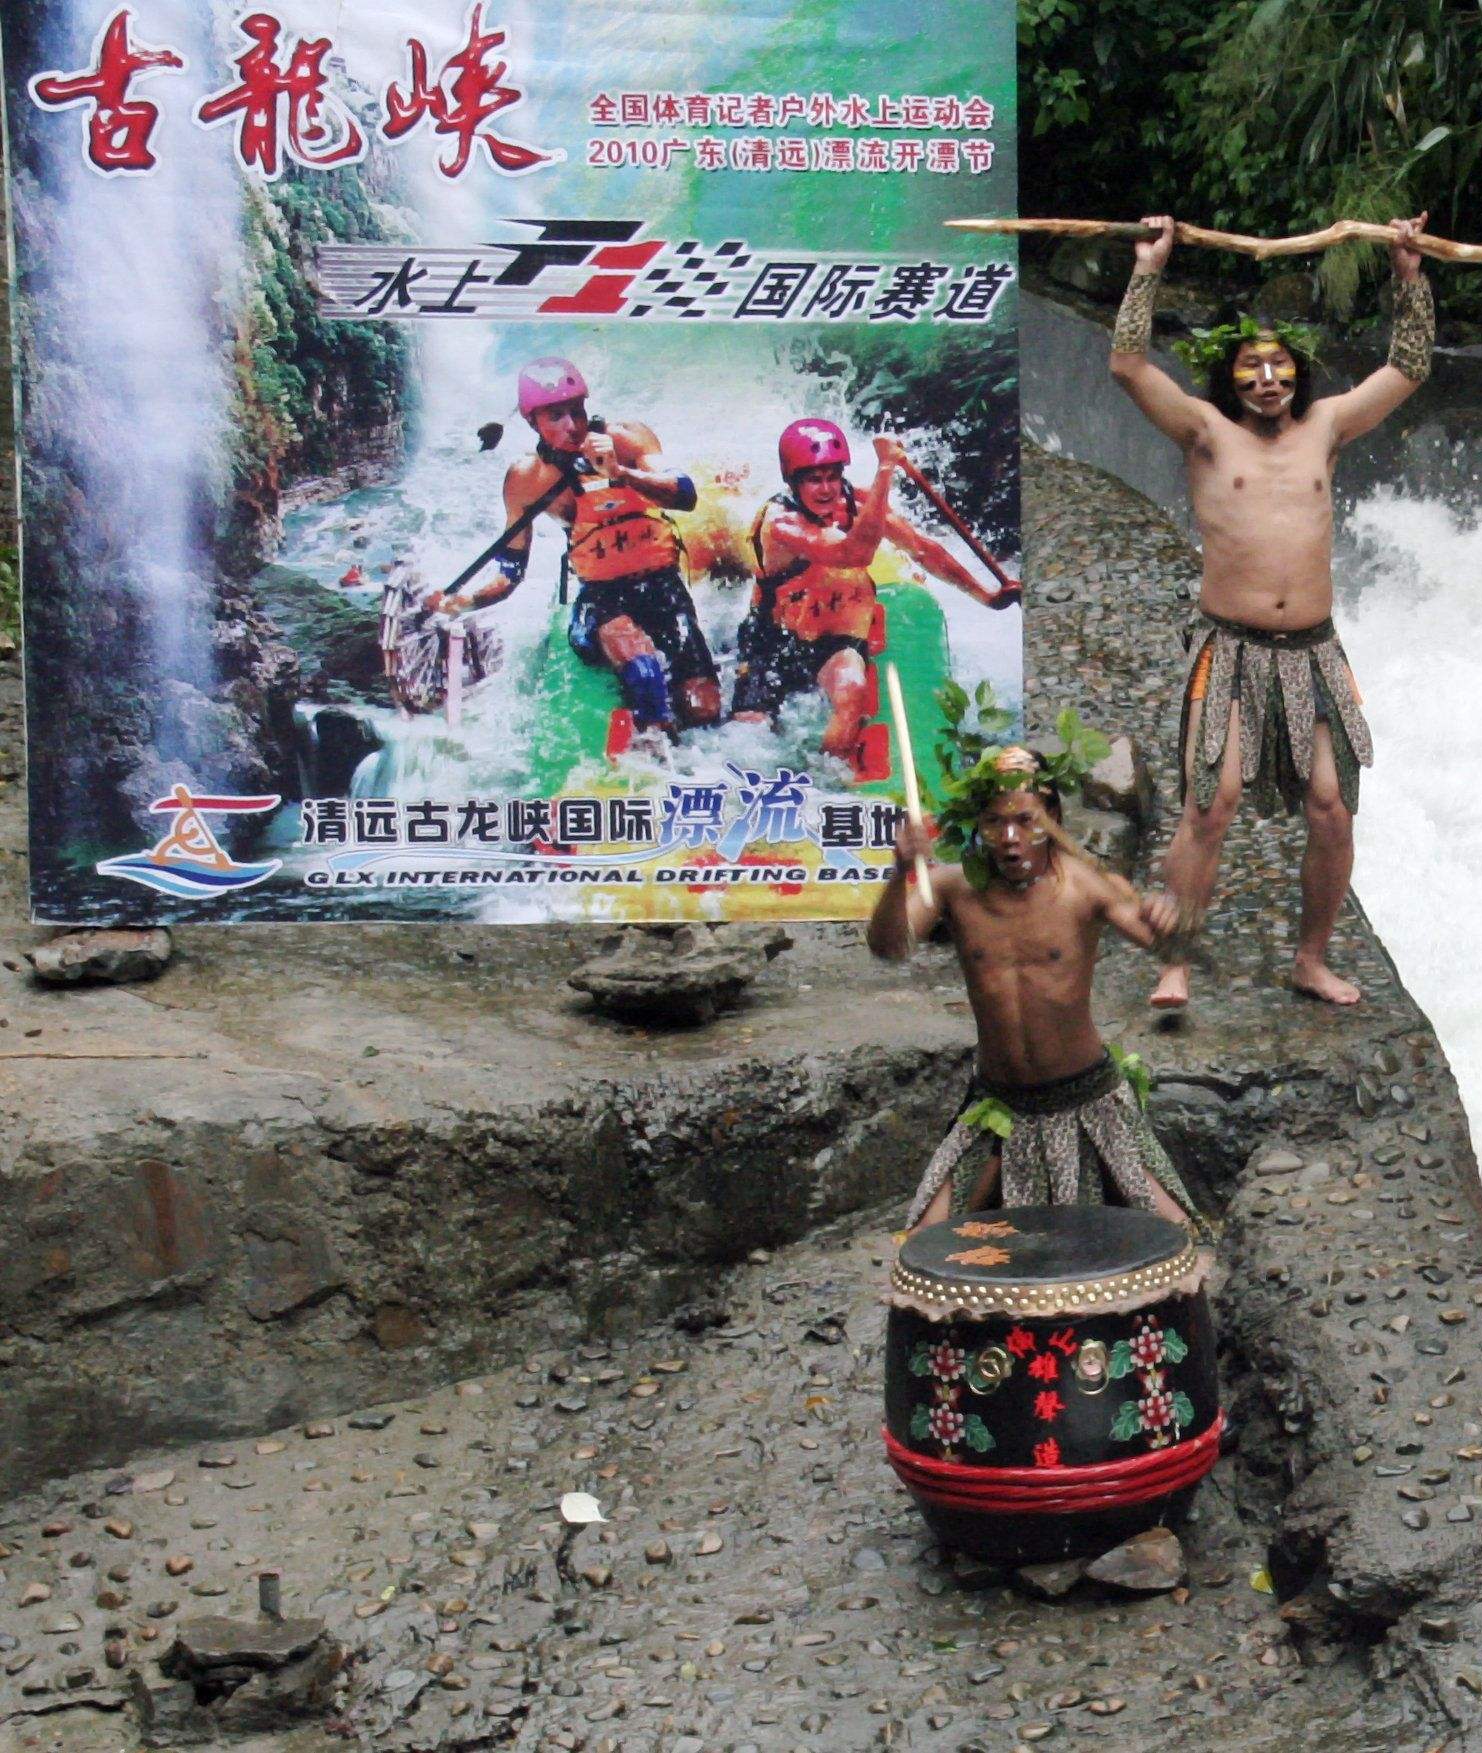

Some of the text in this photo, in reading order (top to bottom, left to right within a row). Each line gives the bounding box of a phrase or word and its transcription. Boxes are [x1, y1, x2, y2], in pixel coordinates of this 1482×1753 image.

[589, 93, 994, 128] 全国体育记者户外水上运动会
[588, 138, 994, 173] 2010广东(清远)漂流开漂节
[354, 218, 1013, 320] 水上 F1 国际赛道
[307, 870, 375, 886] GLX
[385, 869, 643, 885] INTERNATIONAL
[655, 868, 807, 883] DRIFTING
